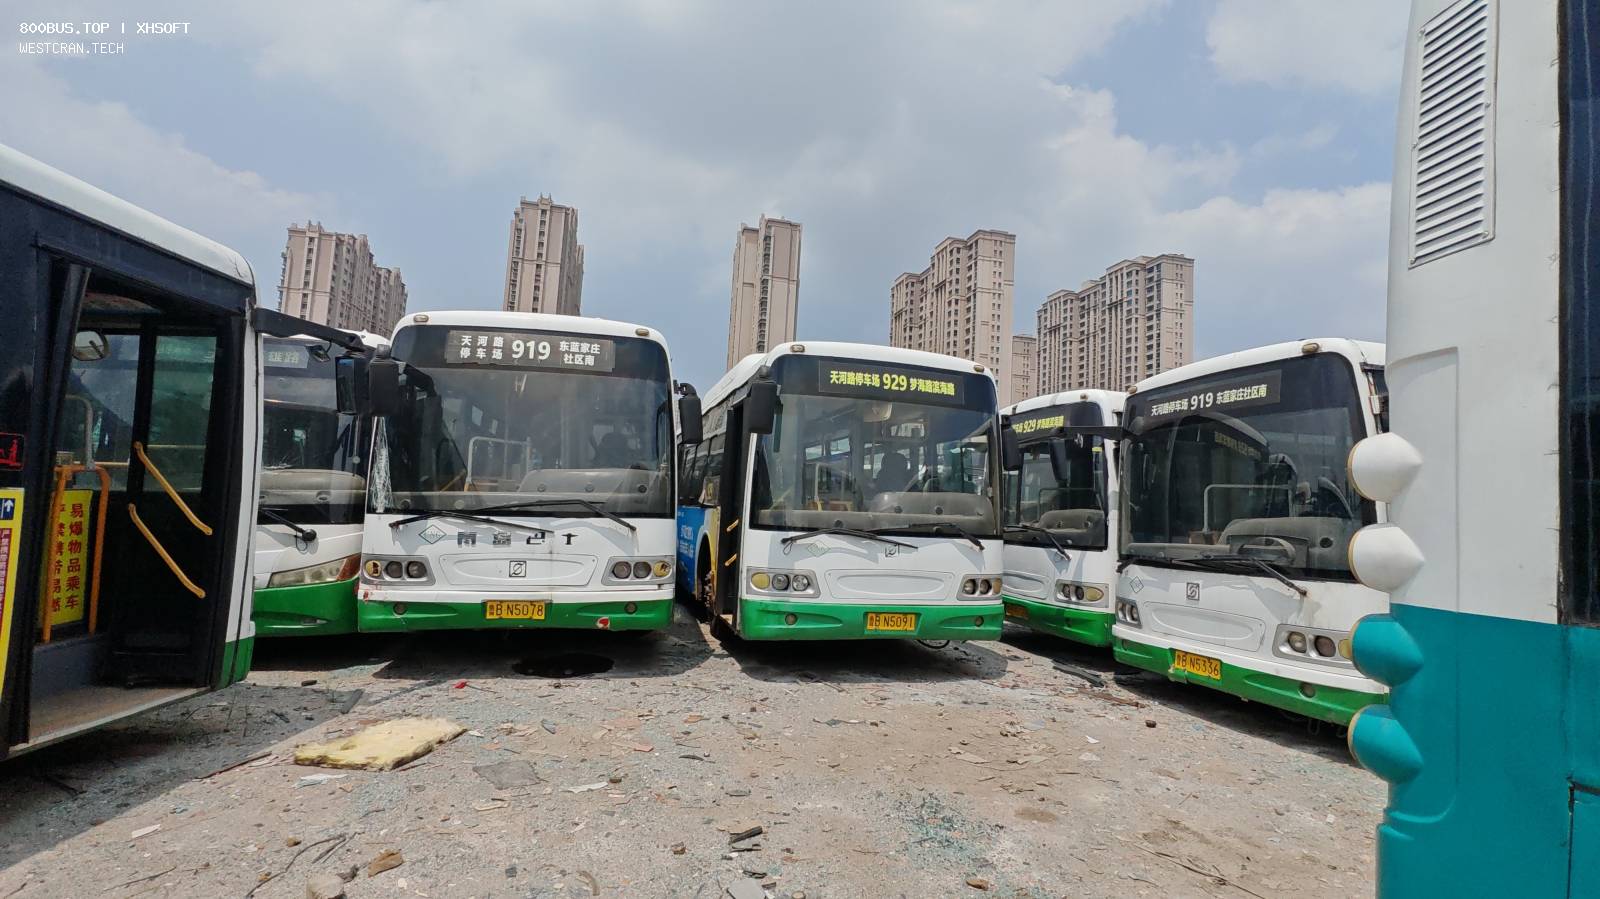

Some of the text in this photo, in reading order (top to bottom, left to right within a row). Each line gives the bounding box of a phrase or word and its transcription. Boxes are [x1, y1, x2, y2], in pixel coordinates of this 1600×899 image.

[460, 335, 504, 348] 天河路
[511, 339, 551, 360] 919
[460, 347, 503, 361] 停车场
[563, 353, 595, 366] 社区南
[829, 370, 881, 388] 天河路停车场
[882, 373, 908, 391] 929
[1151, 398, 1189, 417] 天河路停车场
[1190, 392, 1214, 411] 919
[65, 503, 84, 609] 易爆物品乘车
